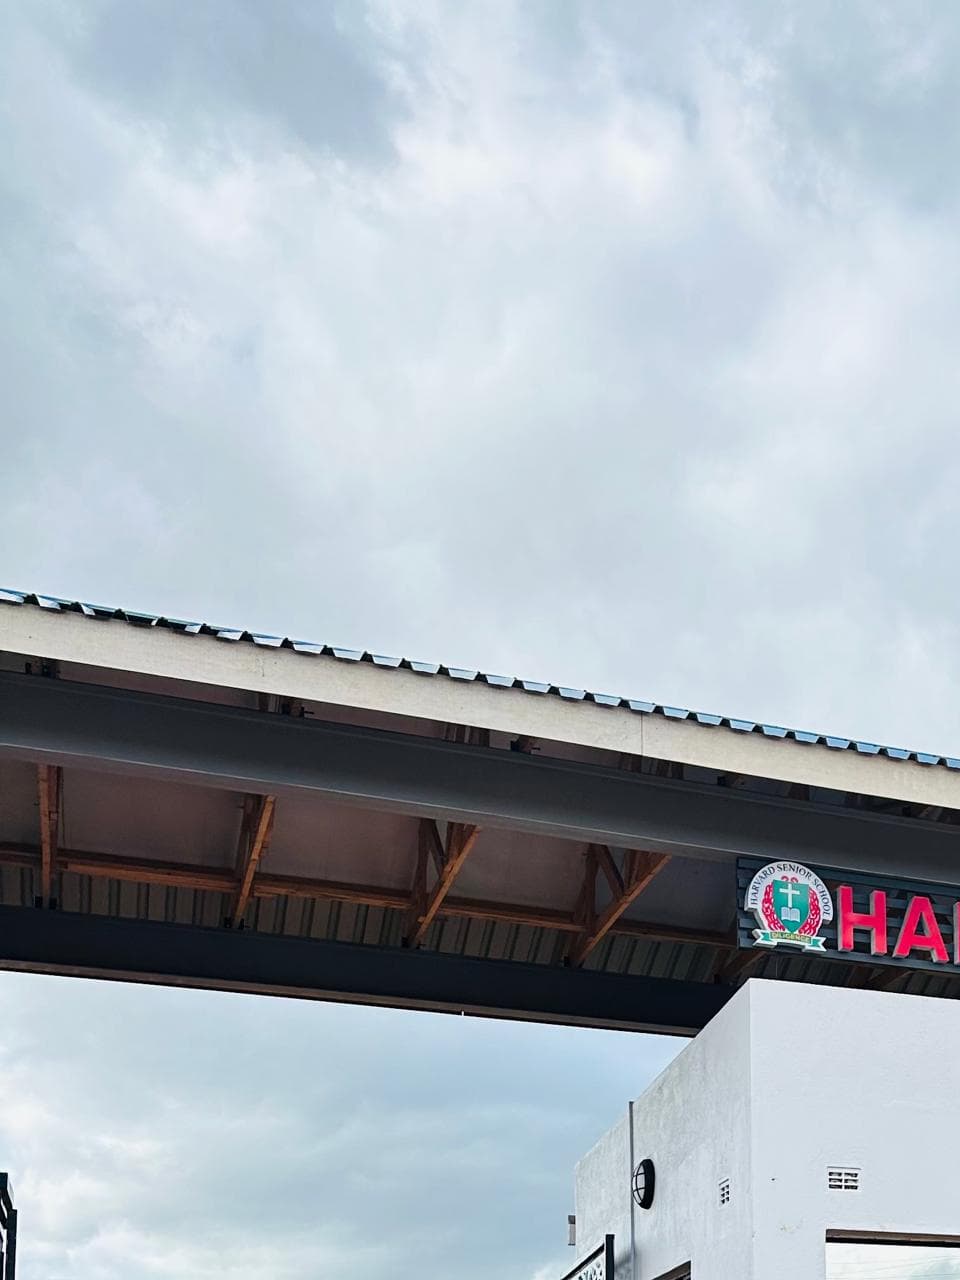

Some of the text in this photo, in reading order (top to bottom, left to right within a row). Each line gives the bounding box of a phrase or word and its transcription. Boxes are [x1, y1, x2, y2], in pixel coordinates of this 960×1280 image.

[751, 863, 831, 916] HARVARD SENIOR SCHOOL
